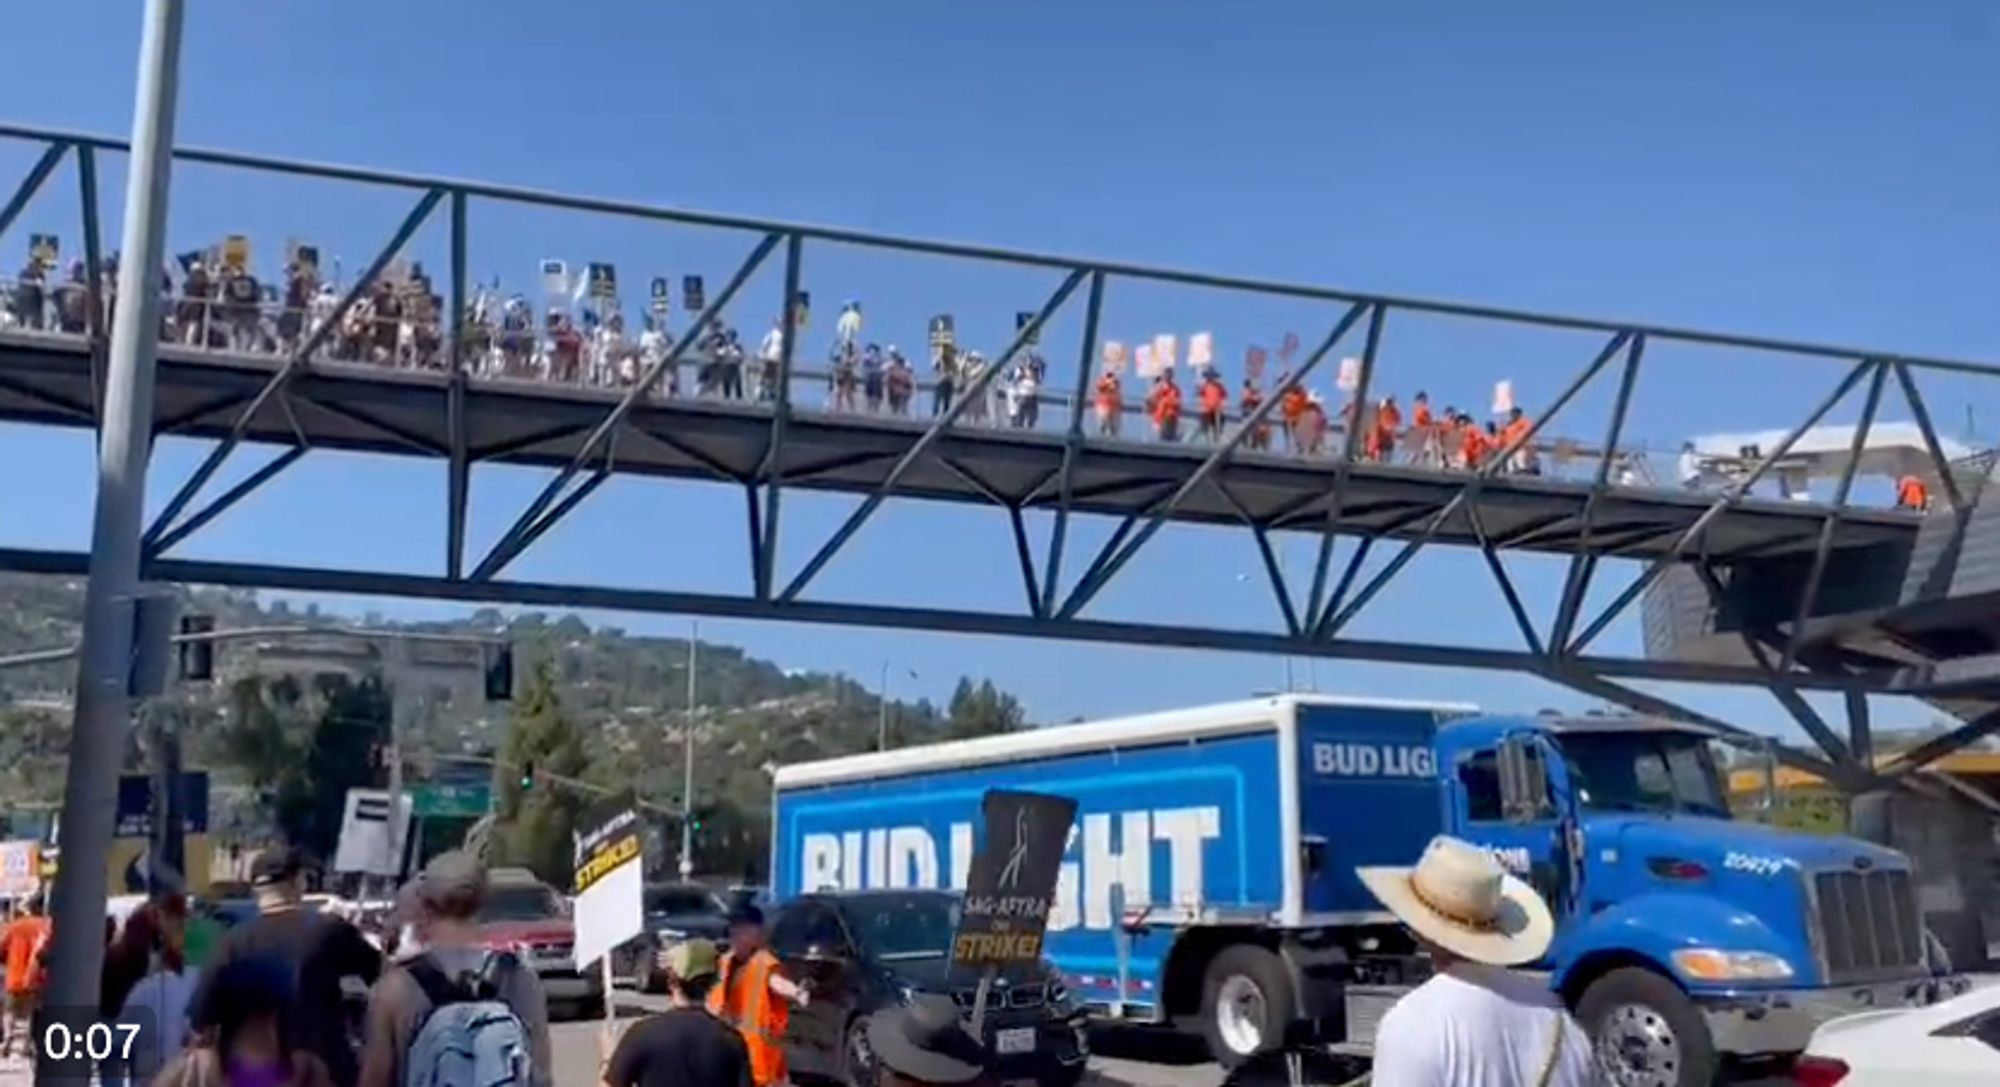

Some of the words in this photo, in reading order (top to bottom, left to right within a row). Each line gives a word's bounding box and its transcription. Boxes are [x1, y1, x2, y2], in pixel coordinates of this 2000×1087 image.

[1313, 742, 1379, 776] BUD
[803, 826, 938, 894] BUD
[964, 896, 1048, 919] SAG-AFTRA
